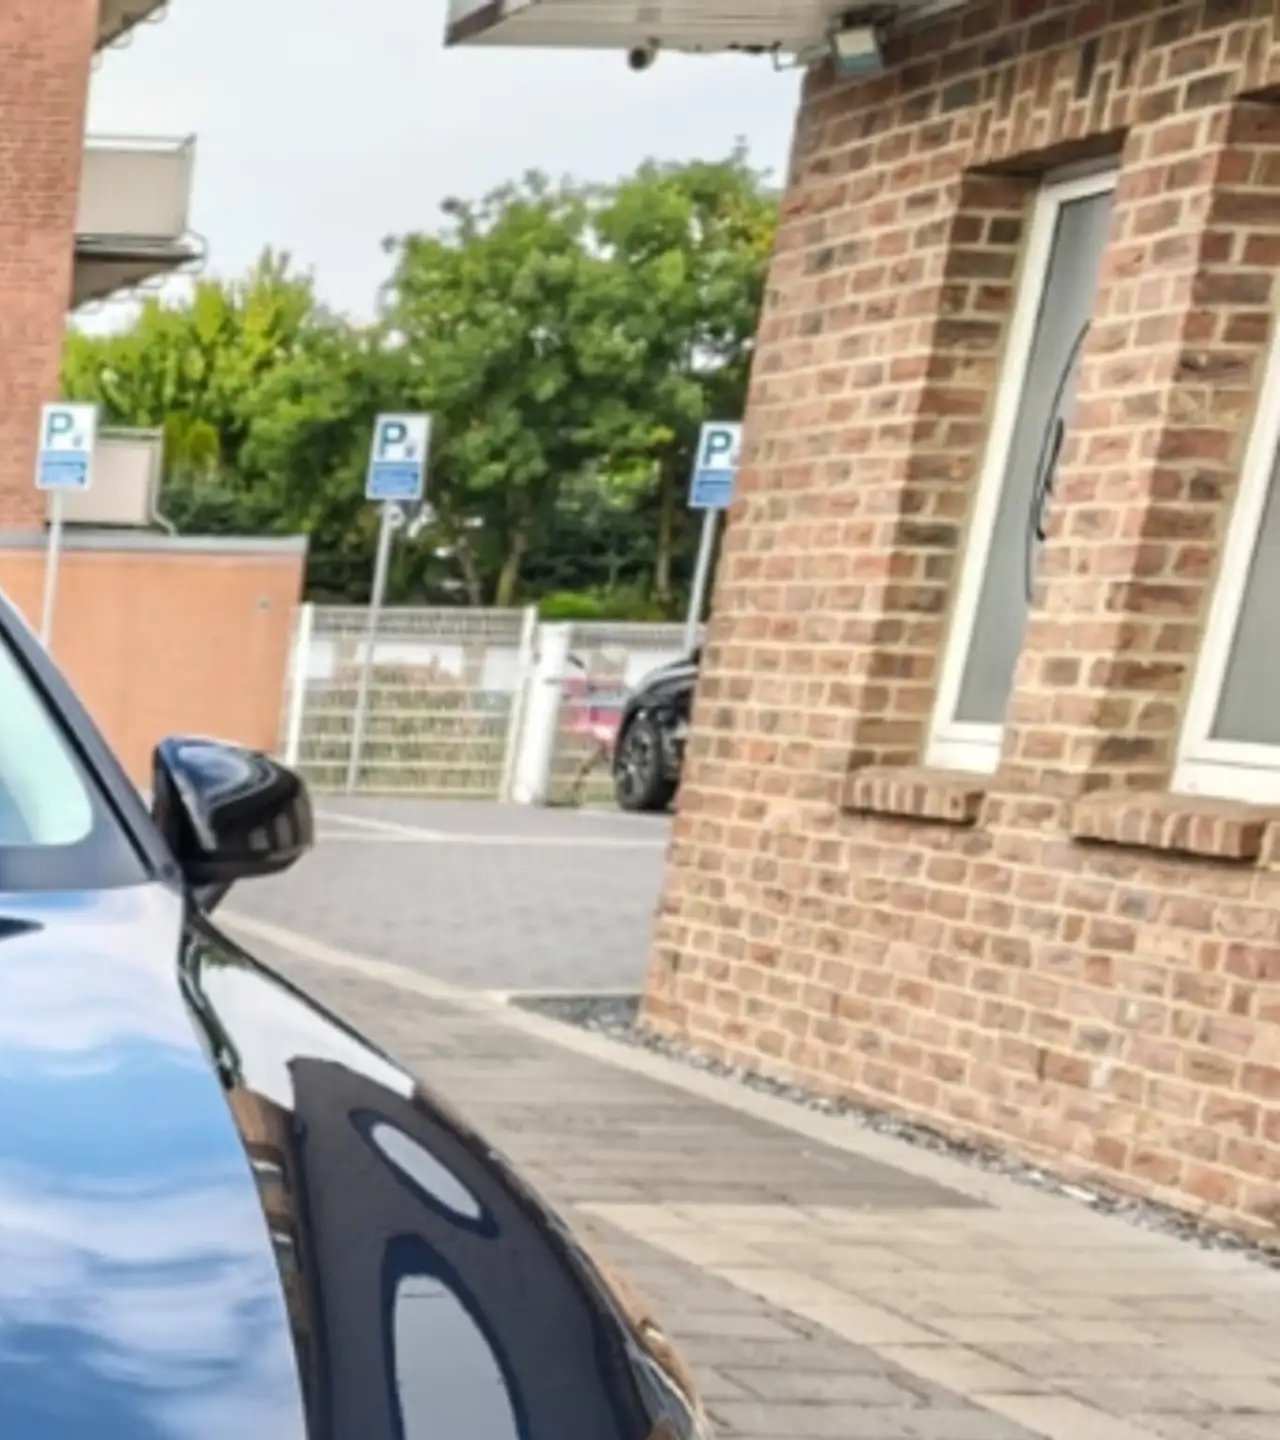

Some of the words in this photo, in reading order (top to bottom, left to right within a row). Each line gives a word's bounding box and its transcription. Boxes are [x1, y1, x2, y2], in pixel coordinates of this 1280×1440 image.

[47, 412, 74, 446] P
[380, 421, 407, 457] P
[703, 430, 733, 466] P
